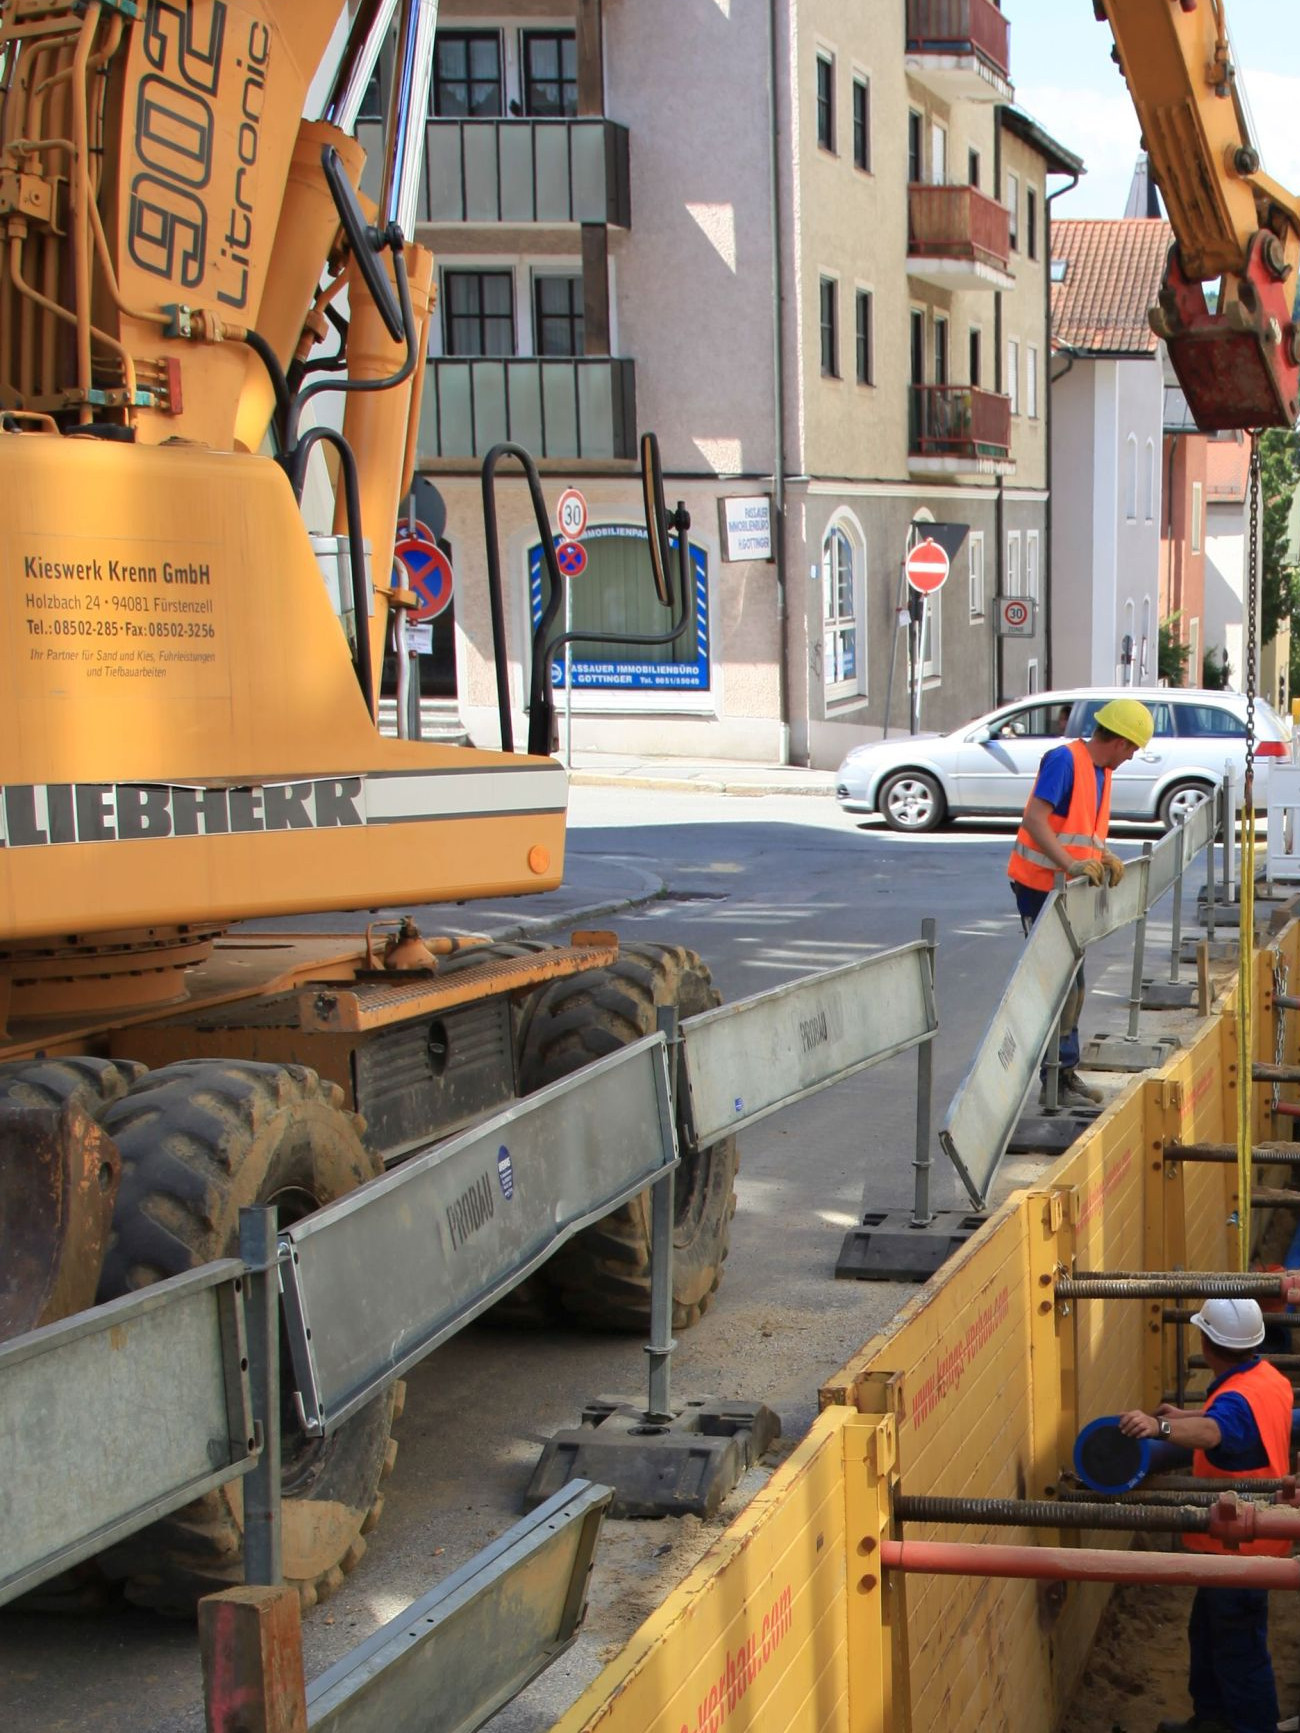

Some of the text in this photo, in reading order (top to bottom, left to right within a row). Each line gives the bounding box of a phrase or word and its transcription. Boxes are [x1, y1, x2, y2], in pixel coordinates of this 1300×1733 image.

[127, 0, 227, 289] 902
[217, 21, 271, 309] Litronic
[564, 505, 581, 526] 30
[24, 556, 211, 585] Kieswerk Krenn GmbH
[25, 593, 213, 613] Holzbach 24 94081 Fürstenzell
[1010, 608, 1022, 619] 30
[30, 649, 43, 661] Ihr
[47, 649, 79, 661] Partner
[96, 650, 117, 661] Sand
[119, 651, 134, 661] und
[86, 666, 167, 678] und Tiefbauarbeiten
[4, 777, 366, 847] LIEBHERR
